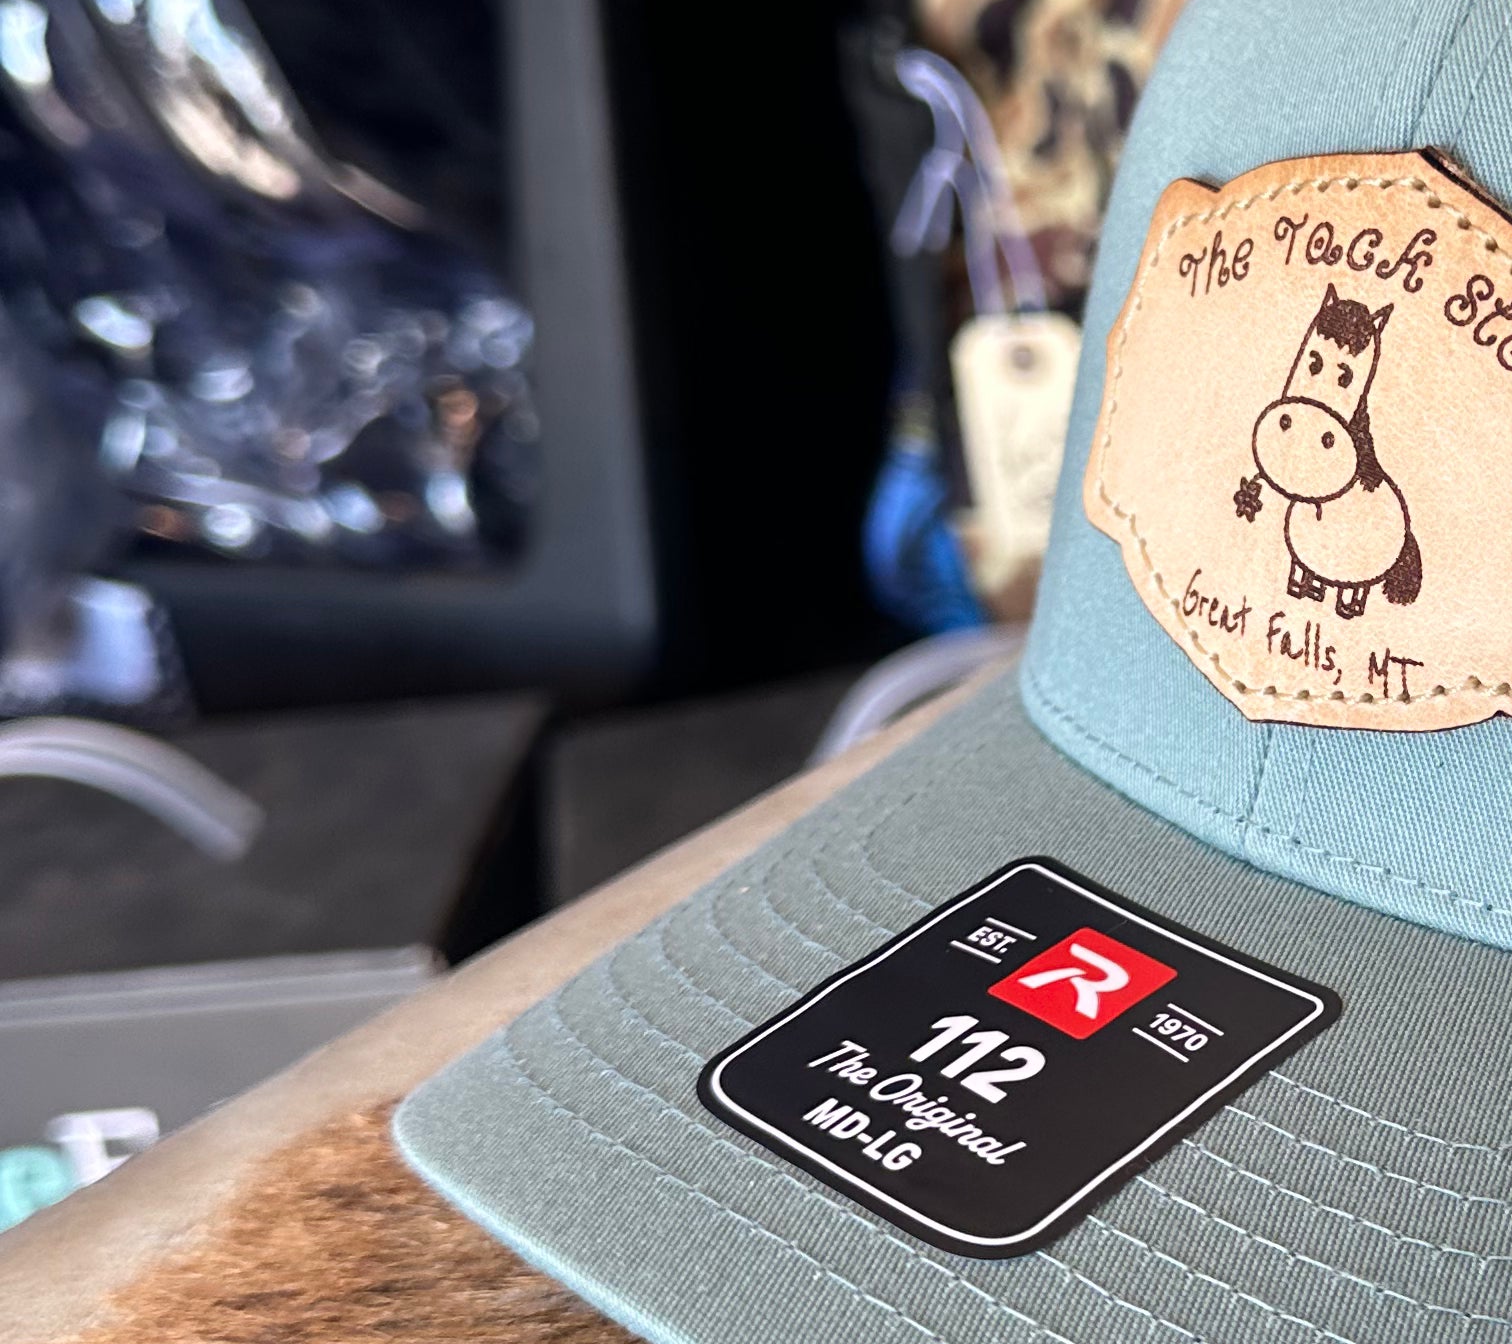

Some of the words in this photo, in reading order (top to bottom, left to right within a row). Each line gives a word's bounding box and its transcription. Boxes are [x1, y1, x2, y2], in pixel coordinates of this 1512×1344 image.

[1179, 230, 1254, 297] The
[1182, 568, 1252, 637] Great
[1266, 610, 1342, 685] Falls,
[1367, 647, 1425, 704] MT
[967, 925, 1017, 954] EST.
[909, 1015, 1046, 1103] 112
[1149, 1010, 1209, 1052] 1970
[802, 1098, 922, 1170] MD-LG
[806, 1039, 879, 1086] The
[868, 1073, 1028, 1166] Original
